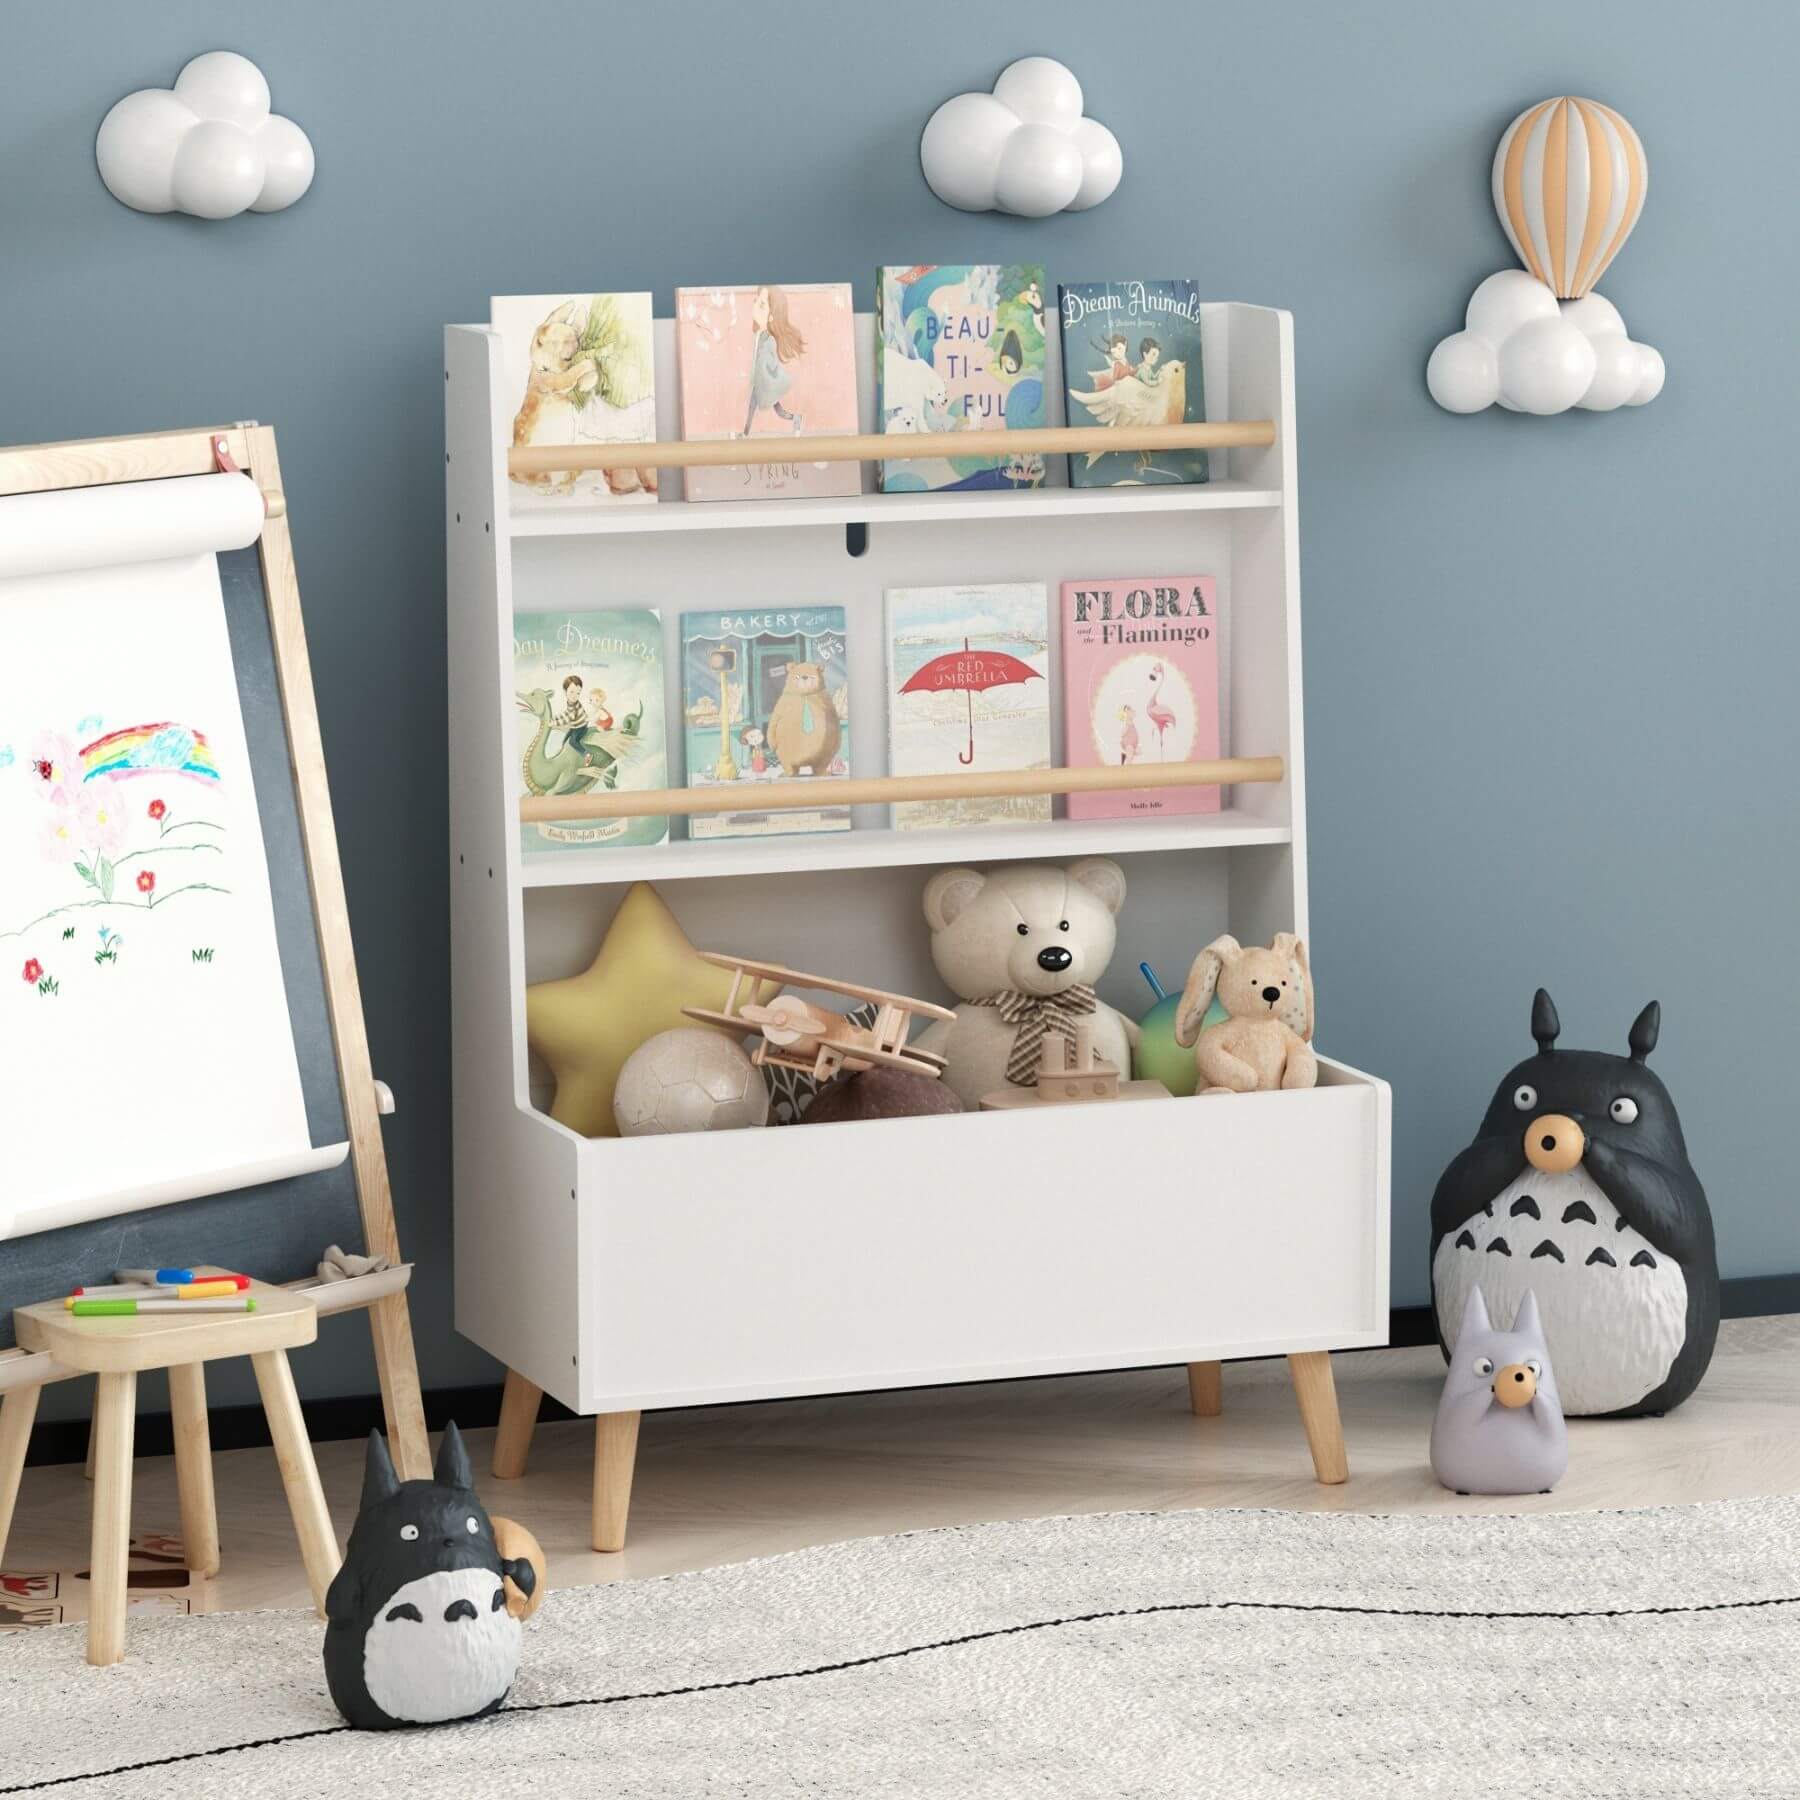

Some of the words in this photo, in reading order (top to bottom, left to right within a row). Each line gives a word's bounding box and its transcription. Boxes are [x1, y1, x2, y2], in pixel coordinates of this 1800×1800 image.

[1063, 289, 1124, 328] Dream
[1128, 281, 1200, 324] Animals
[926, 316, 1005, 340] BEAU-
[946, 355, 983, 379] TI-
[963, 394, 1007, 417] FUL
[1072, 586, 1212, 622] FLORA
[720, 614, 801, 630] BAKERY
[556, 618, 656, 663] Dreamers
[1102, 623, 1210, 647] Flamingo
[934, 670, 1008, 686] UMBRELLA
[957, 660, 984, 673] RED
